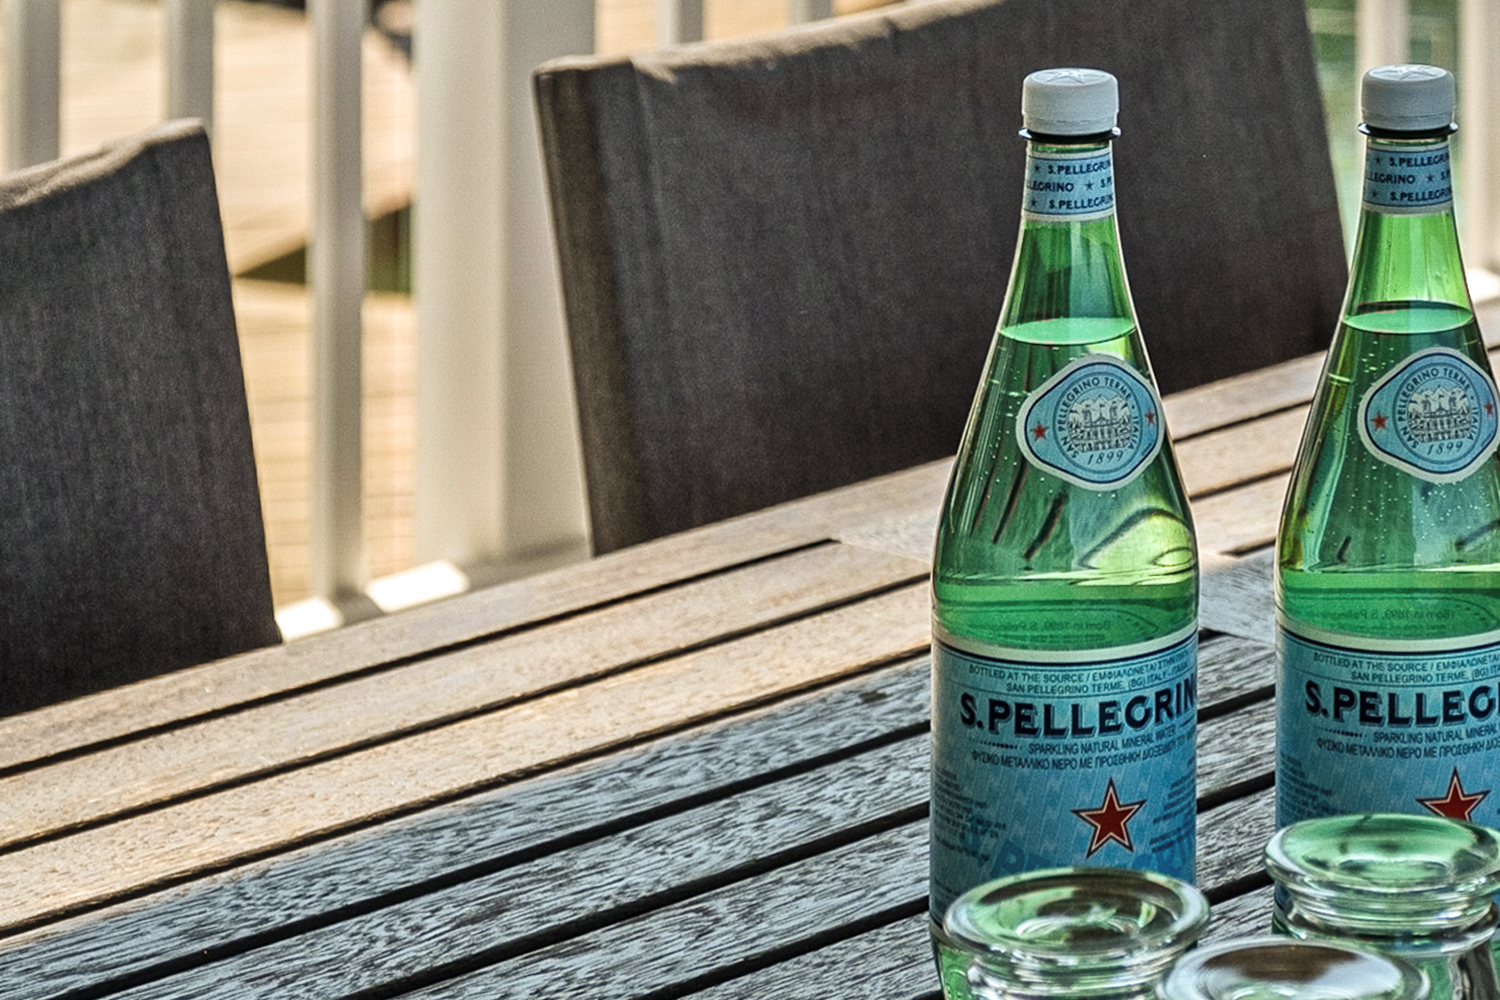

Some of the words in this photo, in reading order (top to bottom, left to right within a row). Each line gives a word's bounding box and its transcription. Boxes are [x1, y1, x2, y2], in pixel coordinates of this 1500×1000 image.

[1104, 377, 1131, 400] TERME
[1443, 367, 1470, 390] TERME
[1057, 377, 1100, 432] PELLEGRINO
[1397, 367, 1439, 422] PELLEGRINO
[1061, 437, 1080, 459] SAN
[1401, 427, 1420, 449] SAN
[1427, 441, 1463, 455] 1899
[1087, 451, 1124, 465] 1899
[1313, 652, 1350, 668] BOTTLED
[1352, 660, 1364, 669] AT
[1367, 661, 1385, 671] THE
[1387, 662, 1428, 672] SOURCE
[969, 664, 1006, 679] BOTTLED
[1007, 672, 1019, 681] AT
[1022, 672, 1040, 681] THE
[1043, 673, 1084, 683] SOURCE
[1351, 671, 1370, 681] SAN
[1372, 673, 1434, 683] PELLEGRINO
[1006, 683, 1025, 692] SAN
[1028, 685, 1089, 694] PELLEGRINO
[1029, 743, 1079, 755] SPARKLING
[1081, 741, 1119, 754] NATURAL
[1122, 733, 1154, 748] MINERAL
[1373, 731, 1424, 744] SPARKLING
[1425, 730, 1464, 742] NATURAL
[1466, 723, 1497, 738] MINERAL
